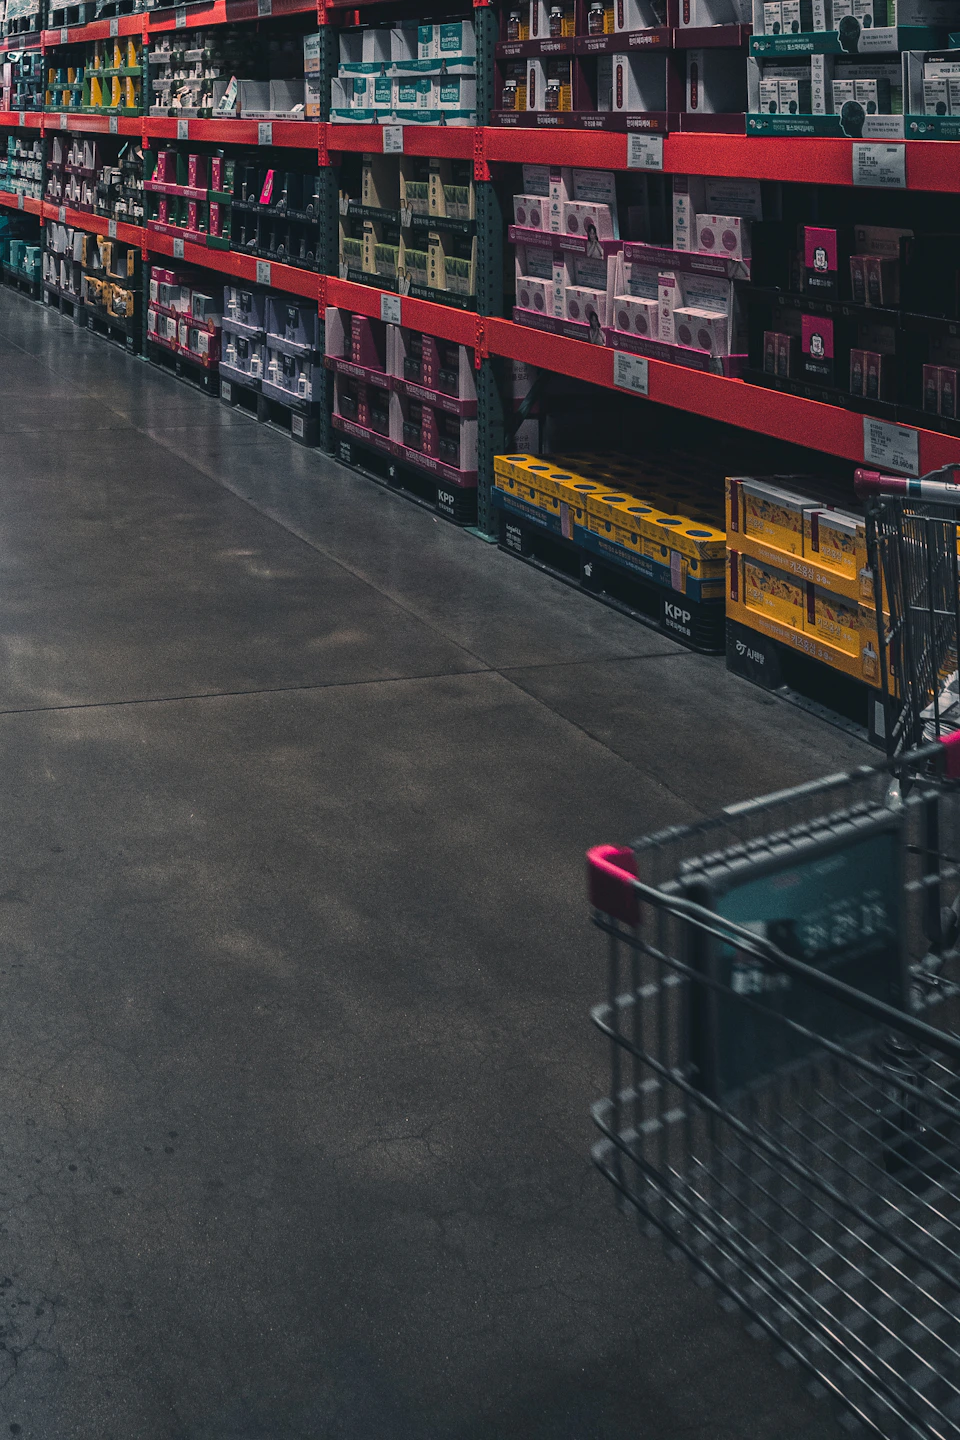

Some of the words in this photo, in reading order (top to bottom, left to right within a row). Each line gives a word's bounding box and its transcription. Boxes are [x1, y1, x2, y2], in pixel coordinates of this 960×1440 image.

[438, 489, 454, 505] KPP
[790, 560, 815, 580] 키즈홍삼
[665, 601, 691, 624] KPP
[790, 633, 816, 654] 키즈홍삼
